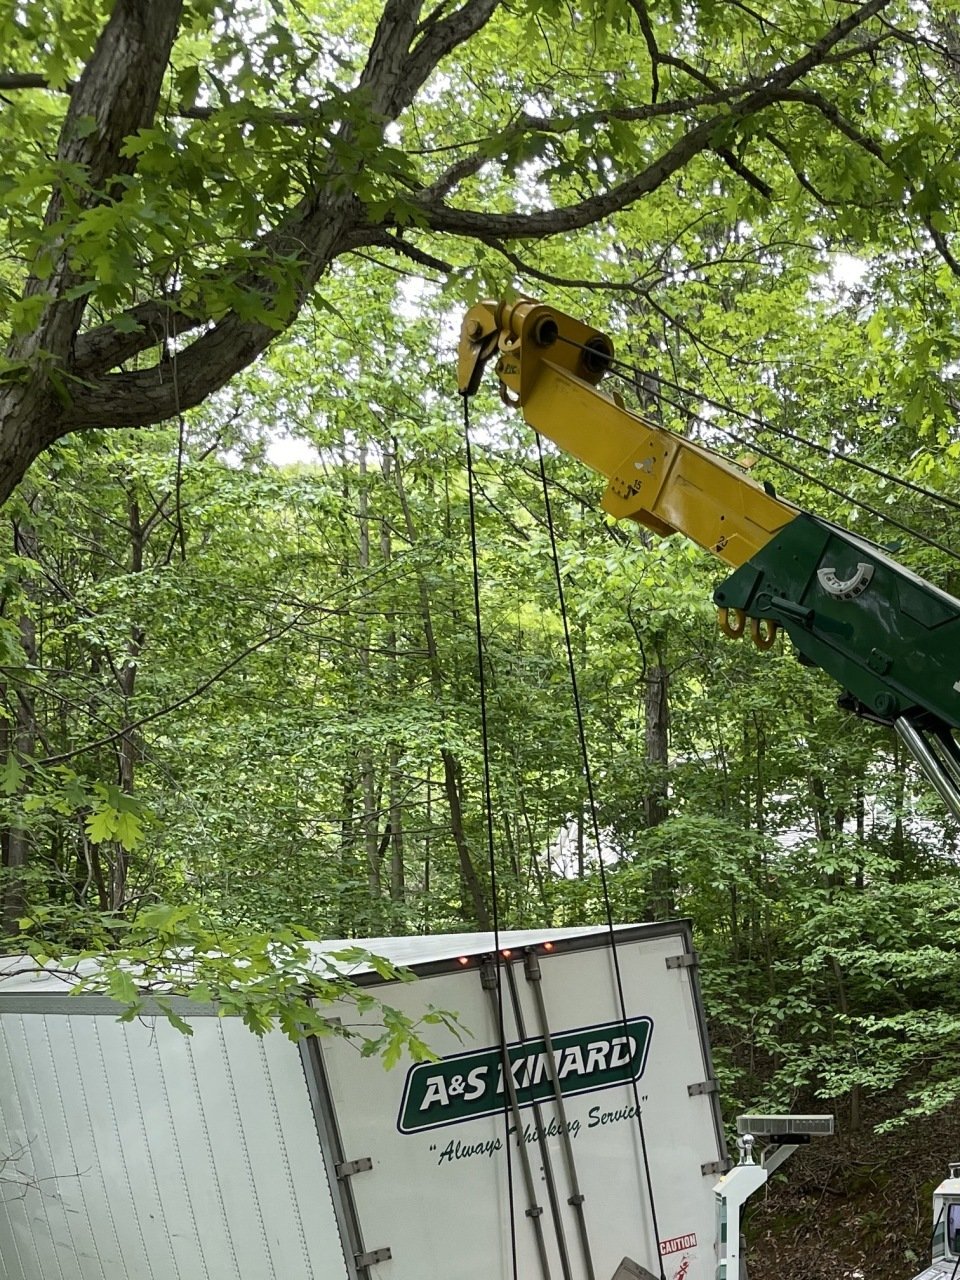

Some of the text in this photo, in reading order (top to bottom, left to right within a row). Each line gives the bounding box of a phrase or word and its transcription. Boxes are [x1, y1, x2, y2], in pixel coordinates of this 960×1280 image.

[419, 1036, 637, 1111] A&S KINARD
[660, 1234, 696, 1255] CAUTION
